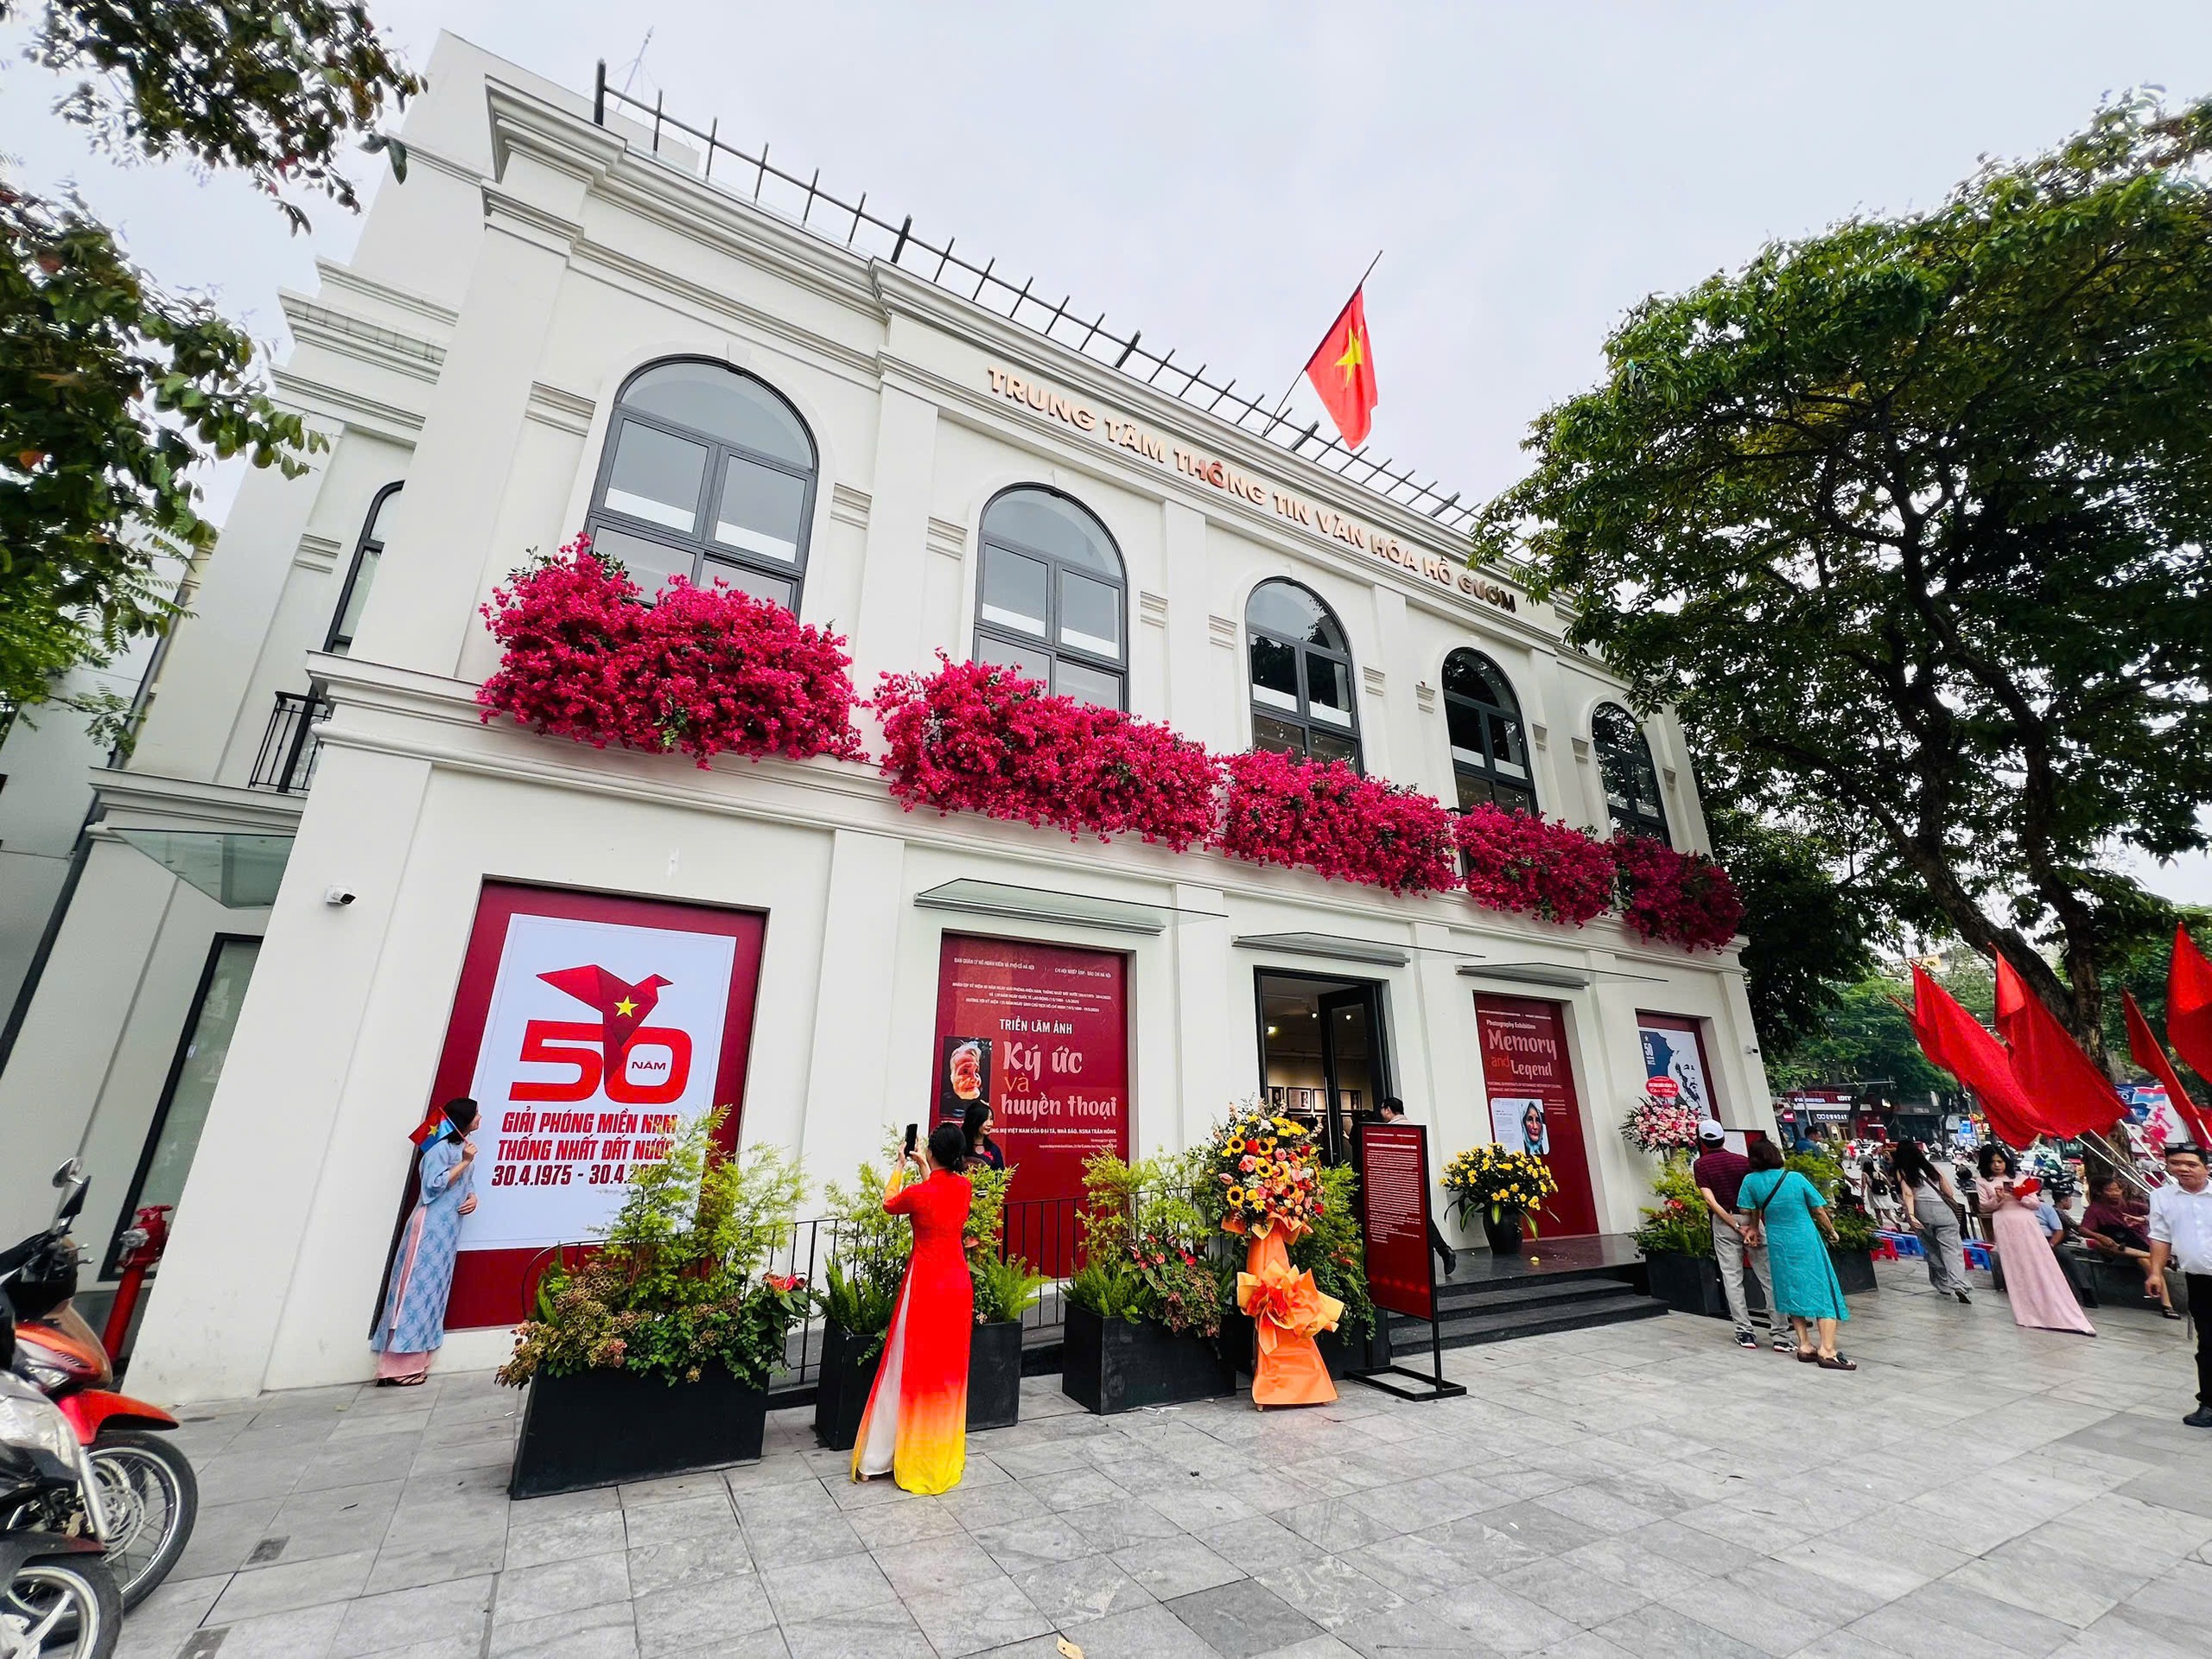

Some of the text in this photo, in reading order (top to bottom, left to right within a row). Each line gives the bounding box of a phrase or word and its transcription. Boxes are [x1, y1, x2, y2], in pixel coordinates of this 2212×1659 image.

[988, 365, 1096, 431] TRUNG
[1104, 416, 1166, 463] TÂM
[1173, 447, 1266, 505] THÔNG
[1273, 491, 1310, 525] TIN
[1315, 511, 1364, 549] VĂN
[1422, 556, 1453, 585] HỒ
[1457, 574, 1516, 613] GƯƠM
[999, 1015, 1072, 1034] TRIỂN LÃM ẢNH
[1487, 1028, 1557, 1061] Memory
[508, 1019, 692, 1104] 50
[1003, 1041, 1083, 1081] Ký ức
[1491, 1054, 1510, 1068] and
[1510, 1059, 1553, 1080] Legend
[1004, 1072, 1030, 1093] và
[501, 1106, 537, 1133] GIẢI
[538, 1109, 595, 1134] PHÓNG
[596, 1108, 639, 1134] MIỀN
[1001, 1091, 1117, 1122] huyền thoại
[497, 1134, 553, 1160] THỐNG
[555, 1134, 599, 1160] NHẤT
[601, 1134, 632, 1160] ĐẤT
[491, 1164, 573, 1186] 30.4.1975
